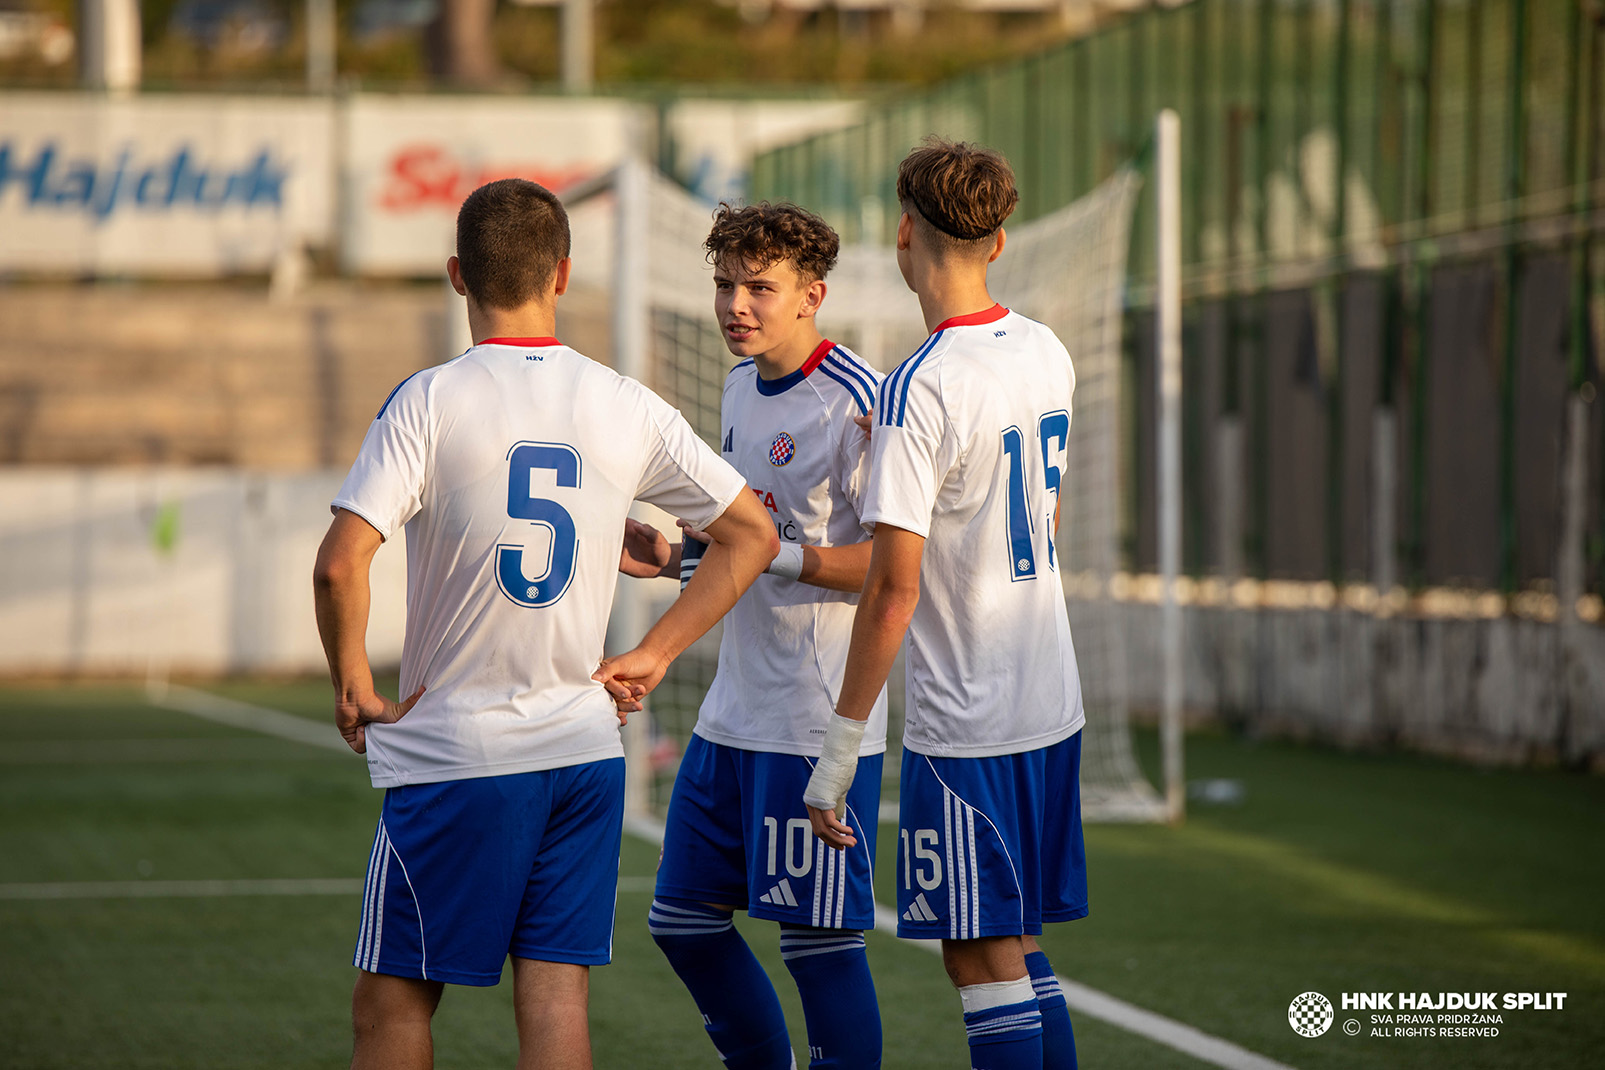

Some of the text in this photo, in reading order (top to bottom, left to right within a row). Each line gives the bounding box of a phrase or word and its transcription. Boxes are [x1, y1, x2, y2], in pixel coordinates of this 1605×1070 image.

[0, 140, 284, 221] Hajduk
[494, 440, 583, 609] 5
[764, 816, 813, 878] 10
[901, 828, 943, 891] 15
